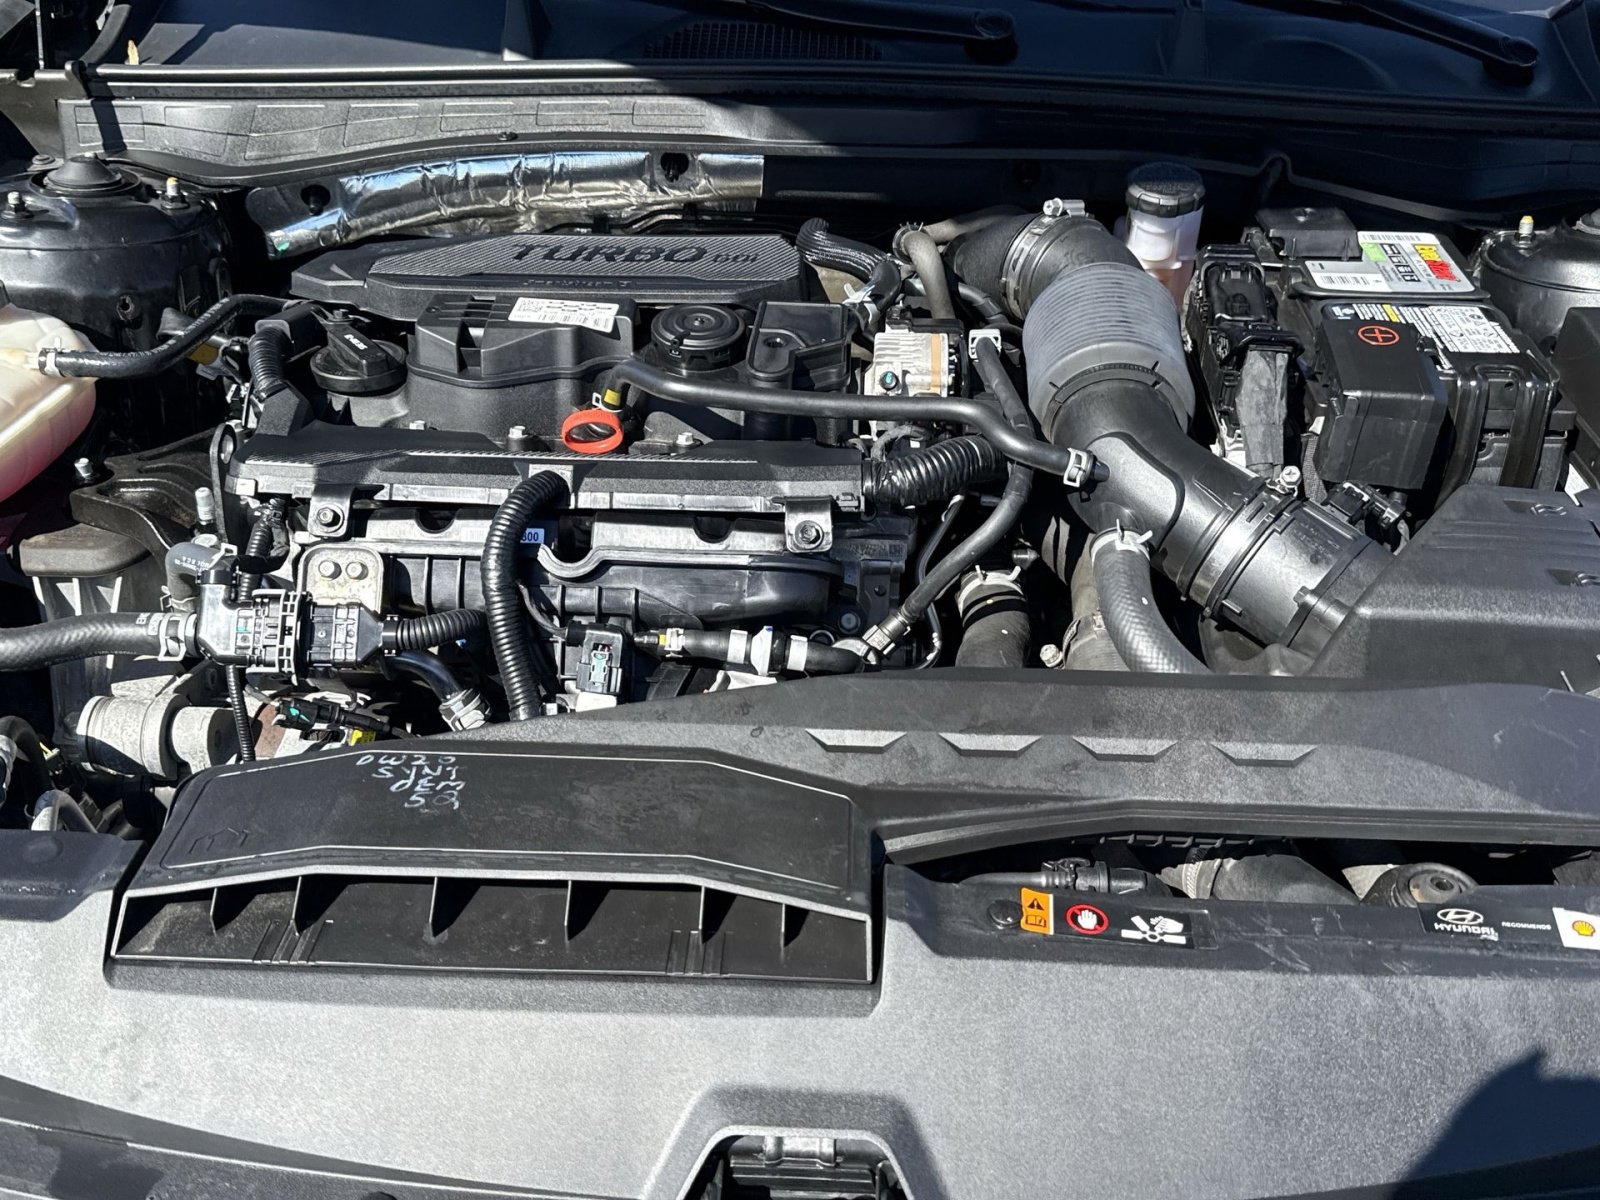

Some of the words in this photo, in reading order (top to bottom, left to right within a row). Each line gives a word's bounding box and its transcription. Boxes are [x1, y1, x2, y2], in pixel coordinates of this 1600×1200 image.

[513, 243, 707, 263] TURBO
[1433, 921, 1497, 937] HYUNDAI
[1501, 920, 1552, 931] RECOMMENDS
